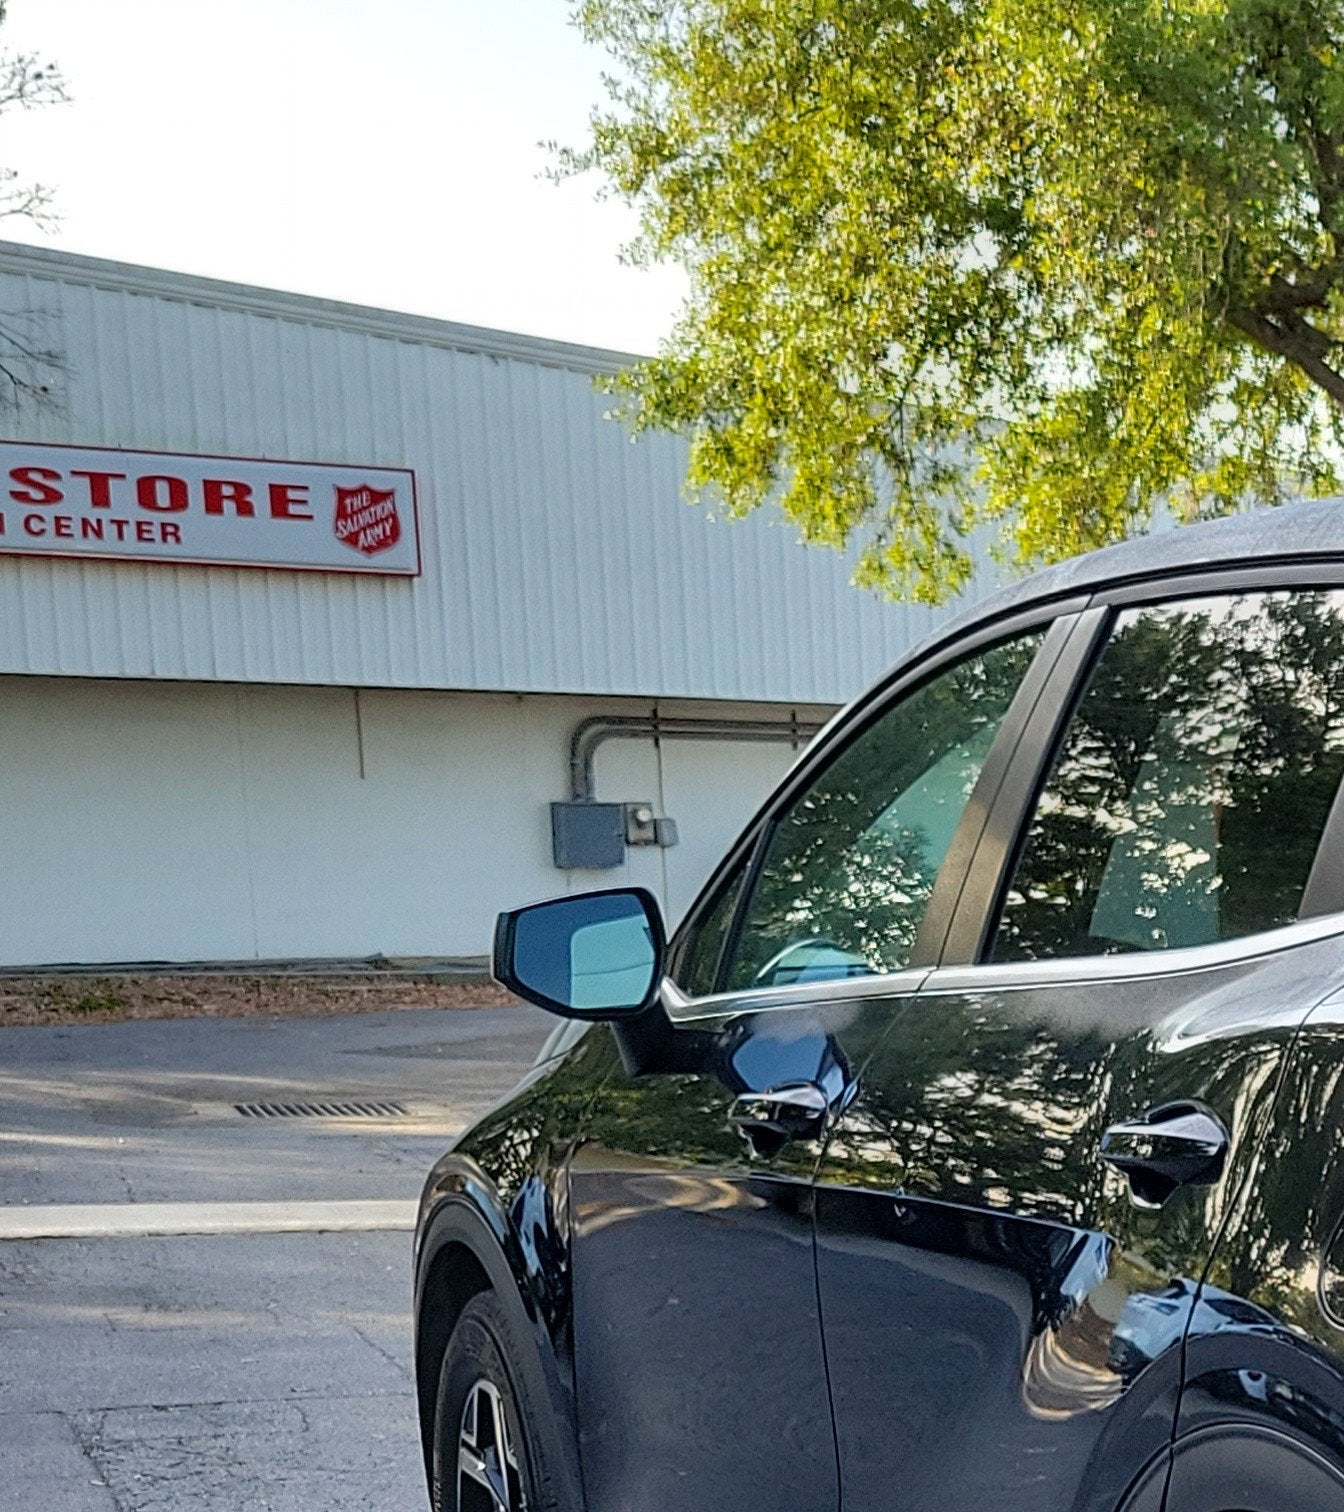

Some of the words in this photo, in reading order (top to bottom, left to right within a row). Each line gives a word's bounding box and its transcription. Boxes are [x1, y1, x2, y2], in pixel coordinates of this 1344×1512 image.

[8, 466, 314, 521] STORE
[344, 490, 371, 515] THE
[23, 513, 183, 545] CENTER
[335, 495, 394, 539] SALVATION
[358, 516, 393, 550] ARMY
